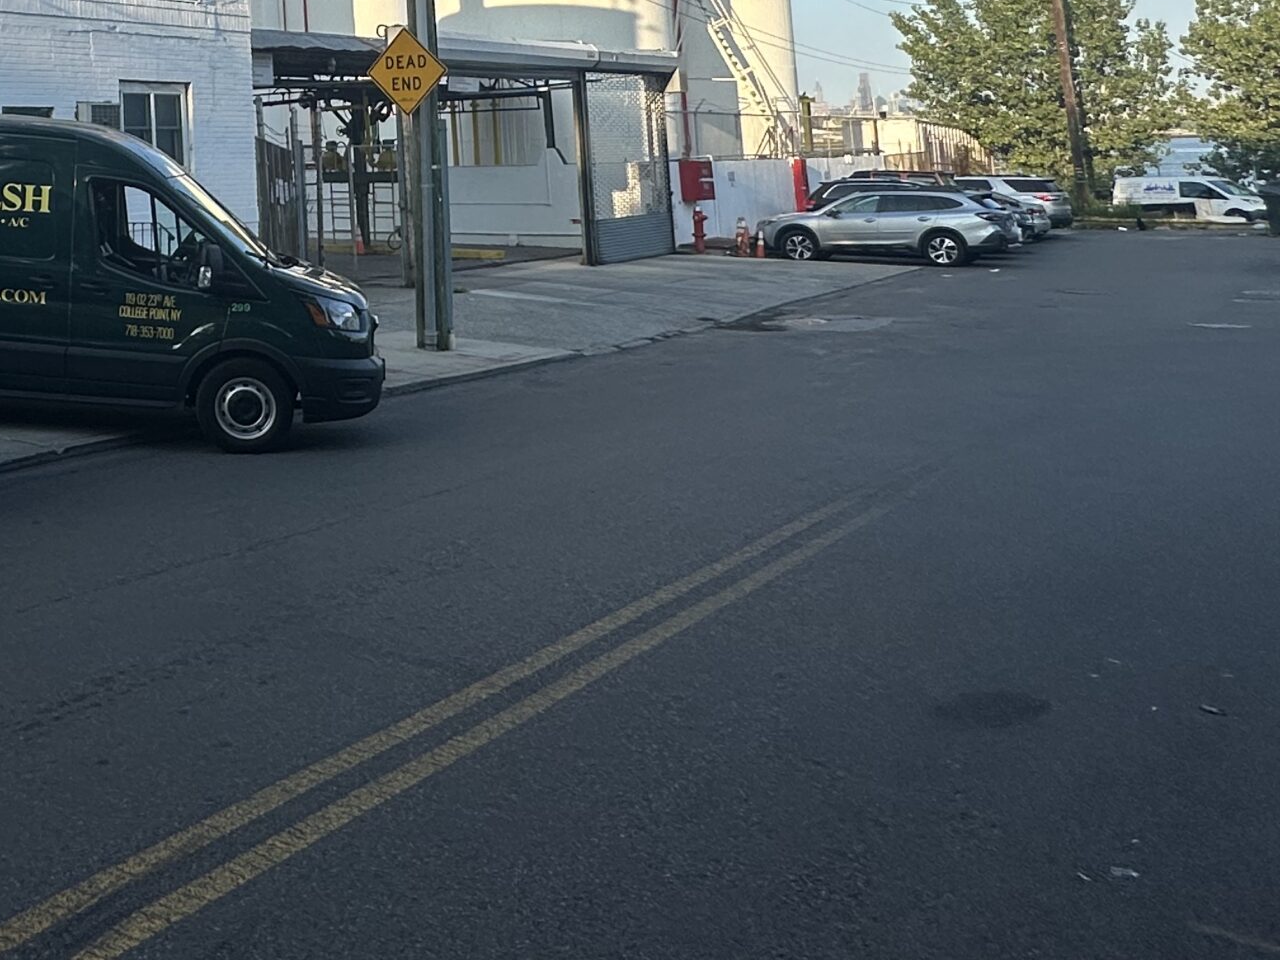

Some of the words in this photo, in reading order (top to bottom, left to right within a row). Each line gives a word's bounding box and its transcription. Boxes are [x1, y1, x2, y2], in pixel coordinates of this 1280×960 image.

[385, 55, 427, 70] DEAD
[392, 76, 422, 91] END
[119, 305, 148, 318] COLLEGE
